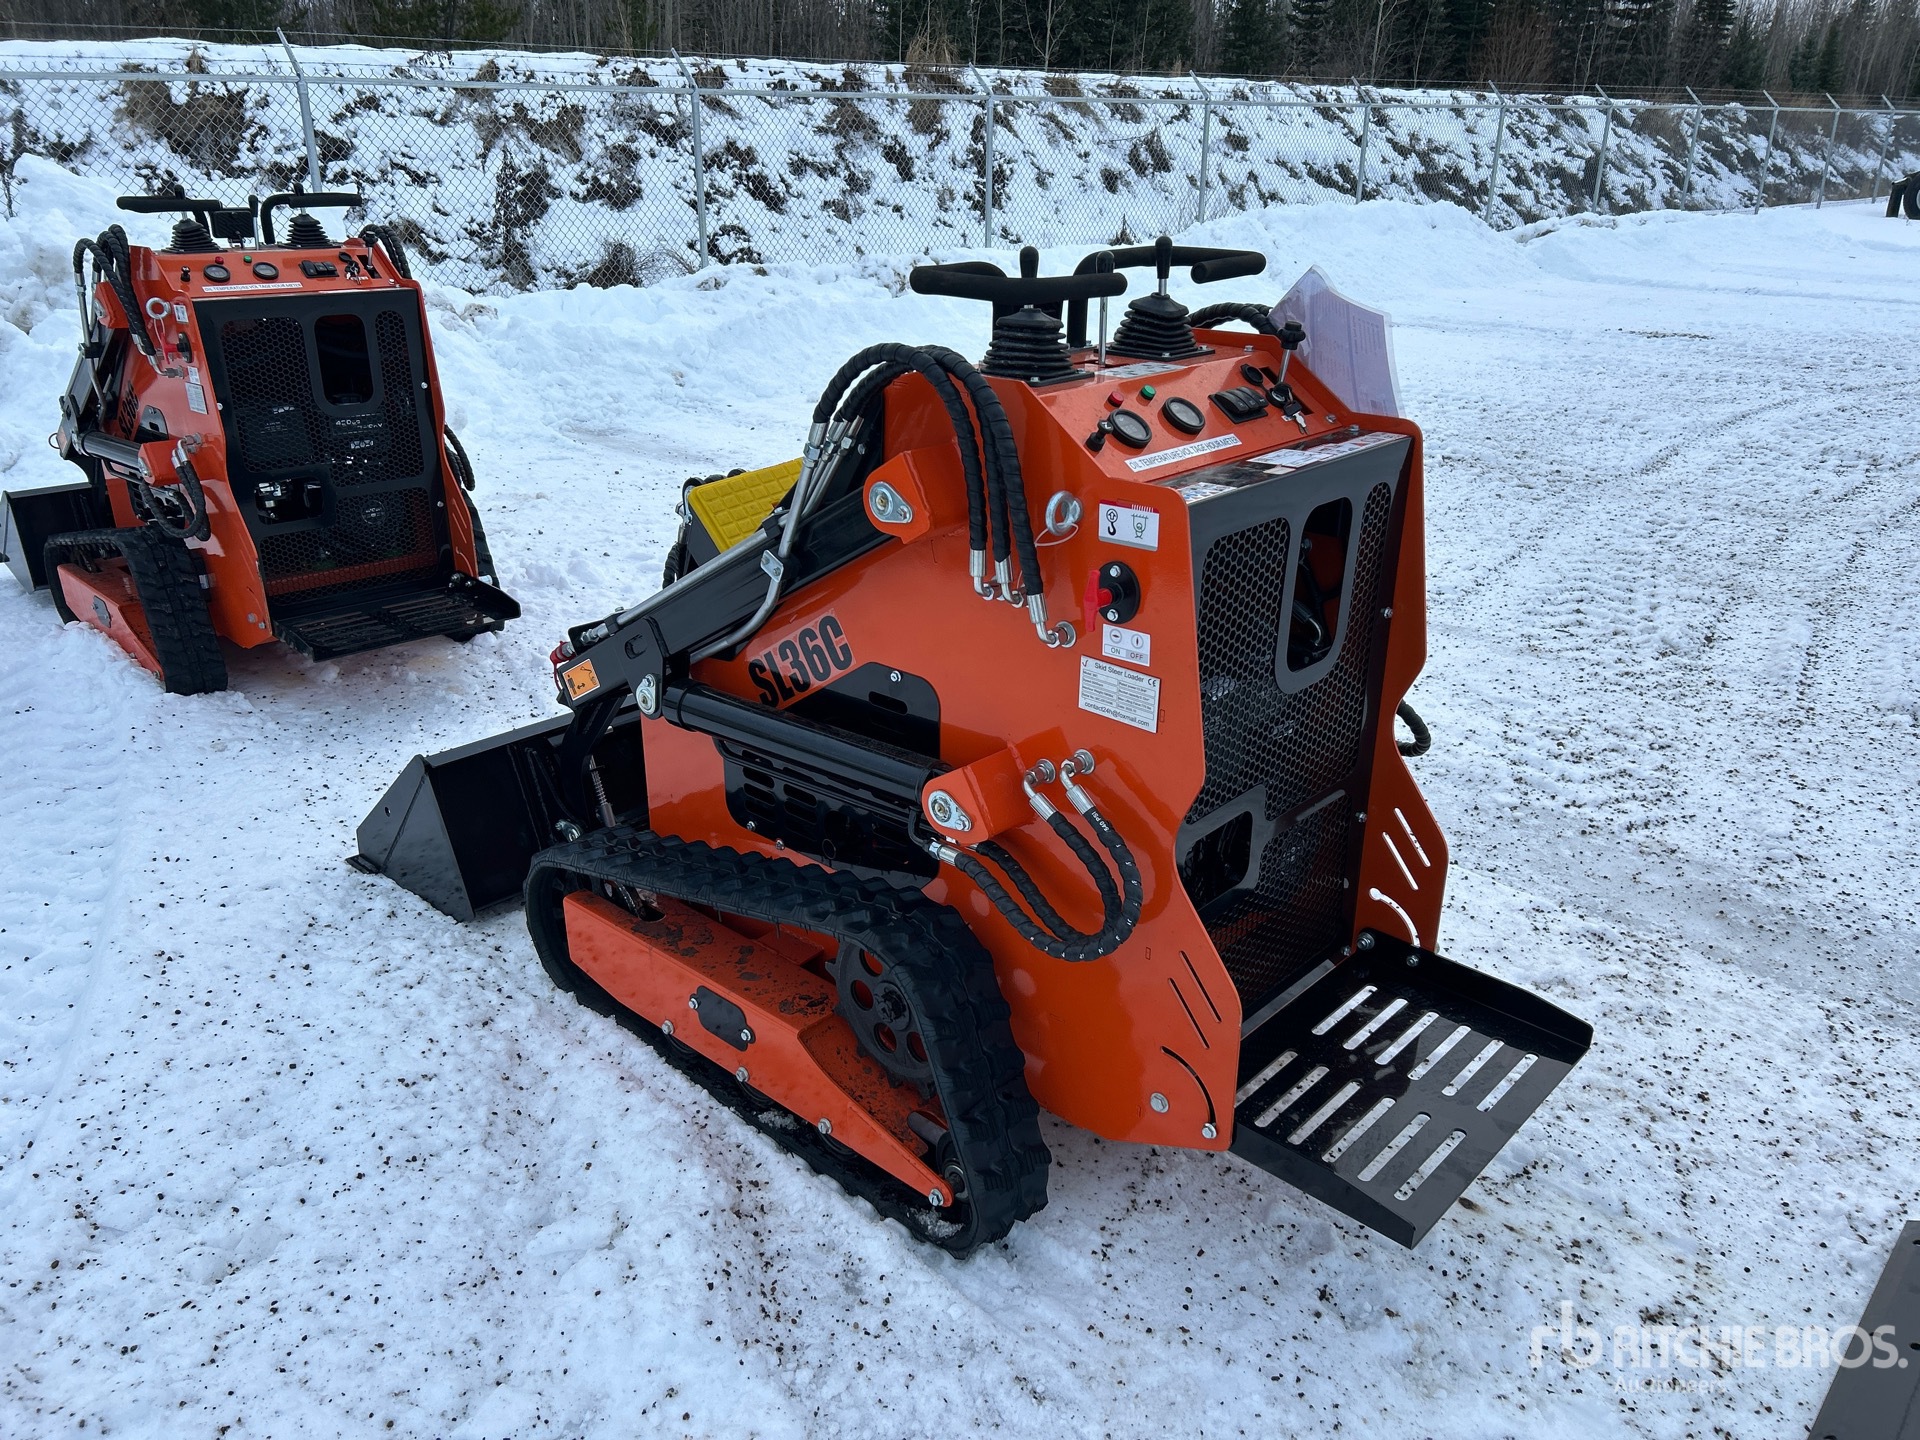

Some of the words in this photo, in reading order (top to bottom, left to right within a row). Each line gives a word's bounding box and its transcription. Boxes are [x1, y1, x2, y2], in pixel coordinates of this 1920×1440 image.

[748, 615, 853, 707] SL36C
[1110, 647, 1121, 655] ON
[1130, 652, 1144, 660] OFF
[1094, 662, 1107, 672] Skid
[1108, 666, 1123, 676] Steer
[1124, 671, 1144, 682] Loader
